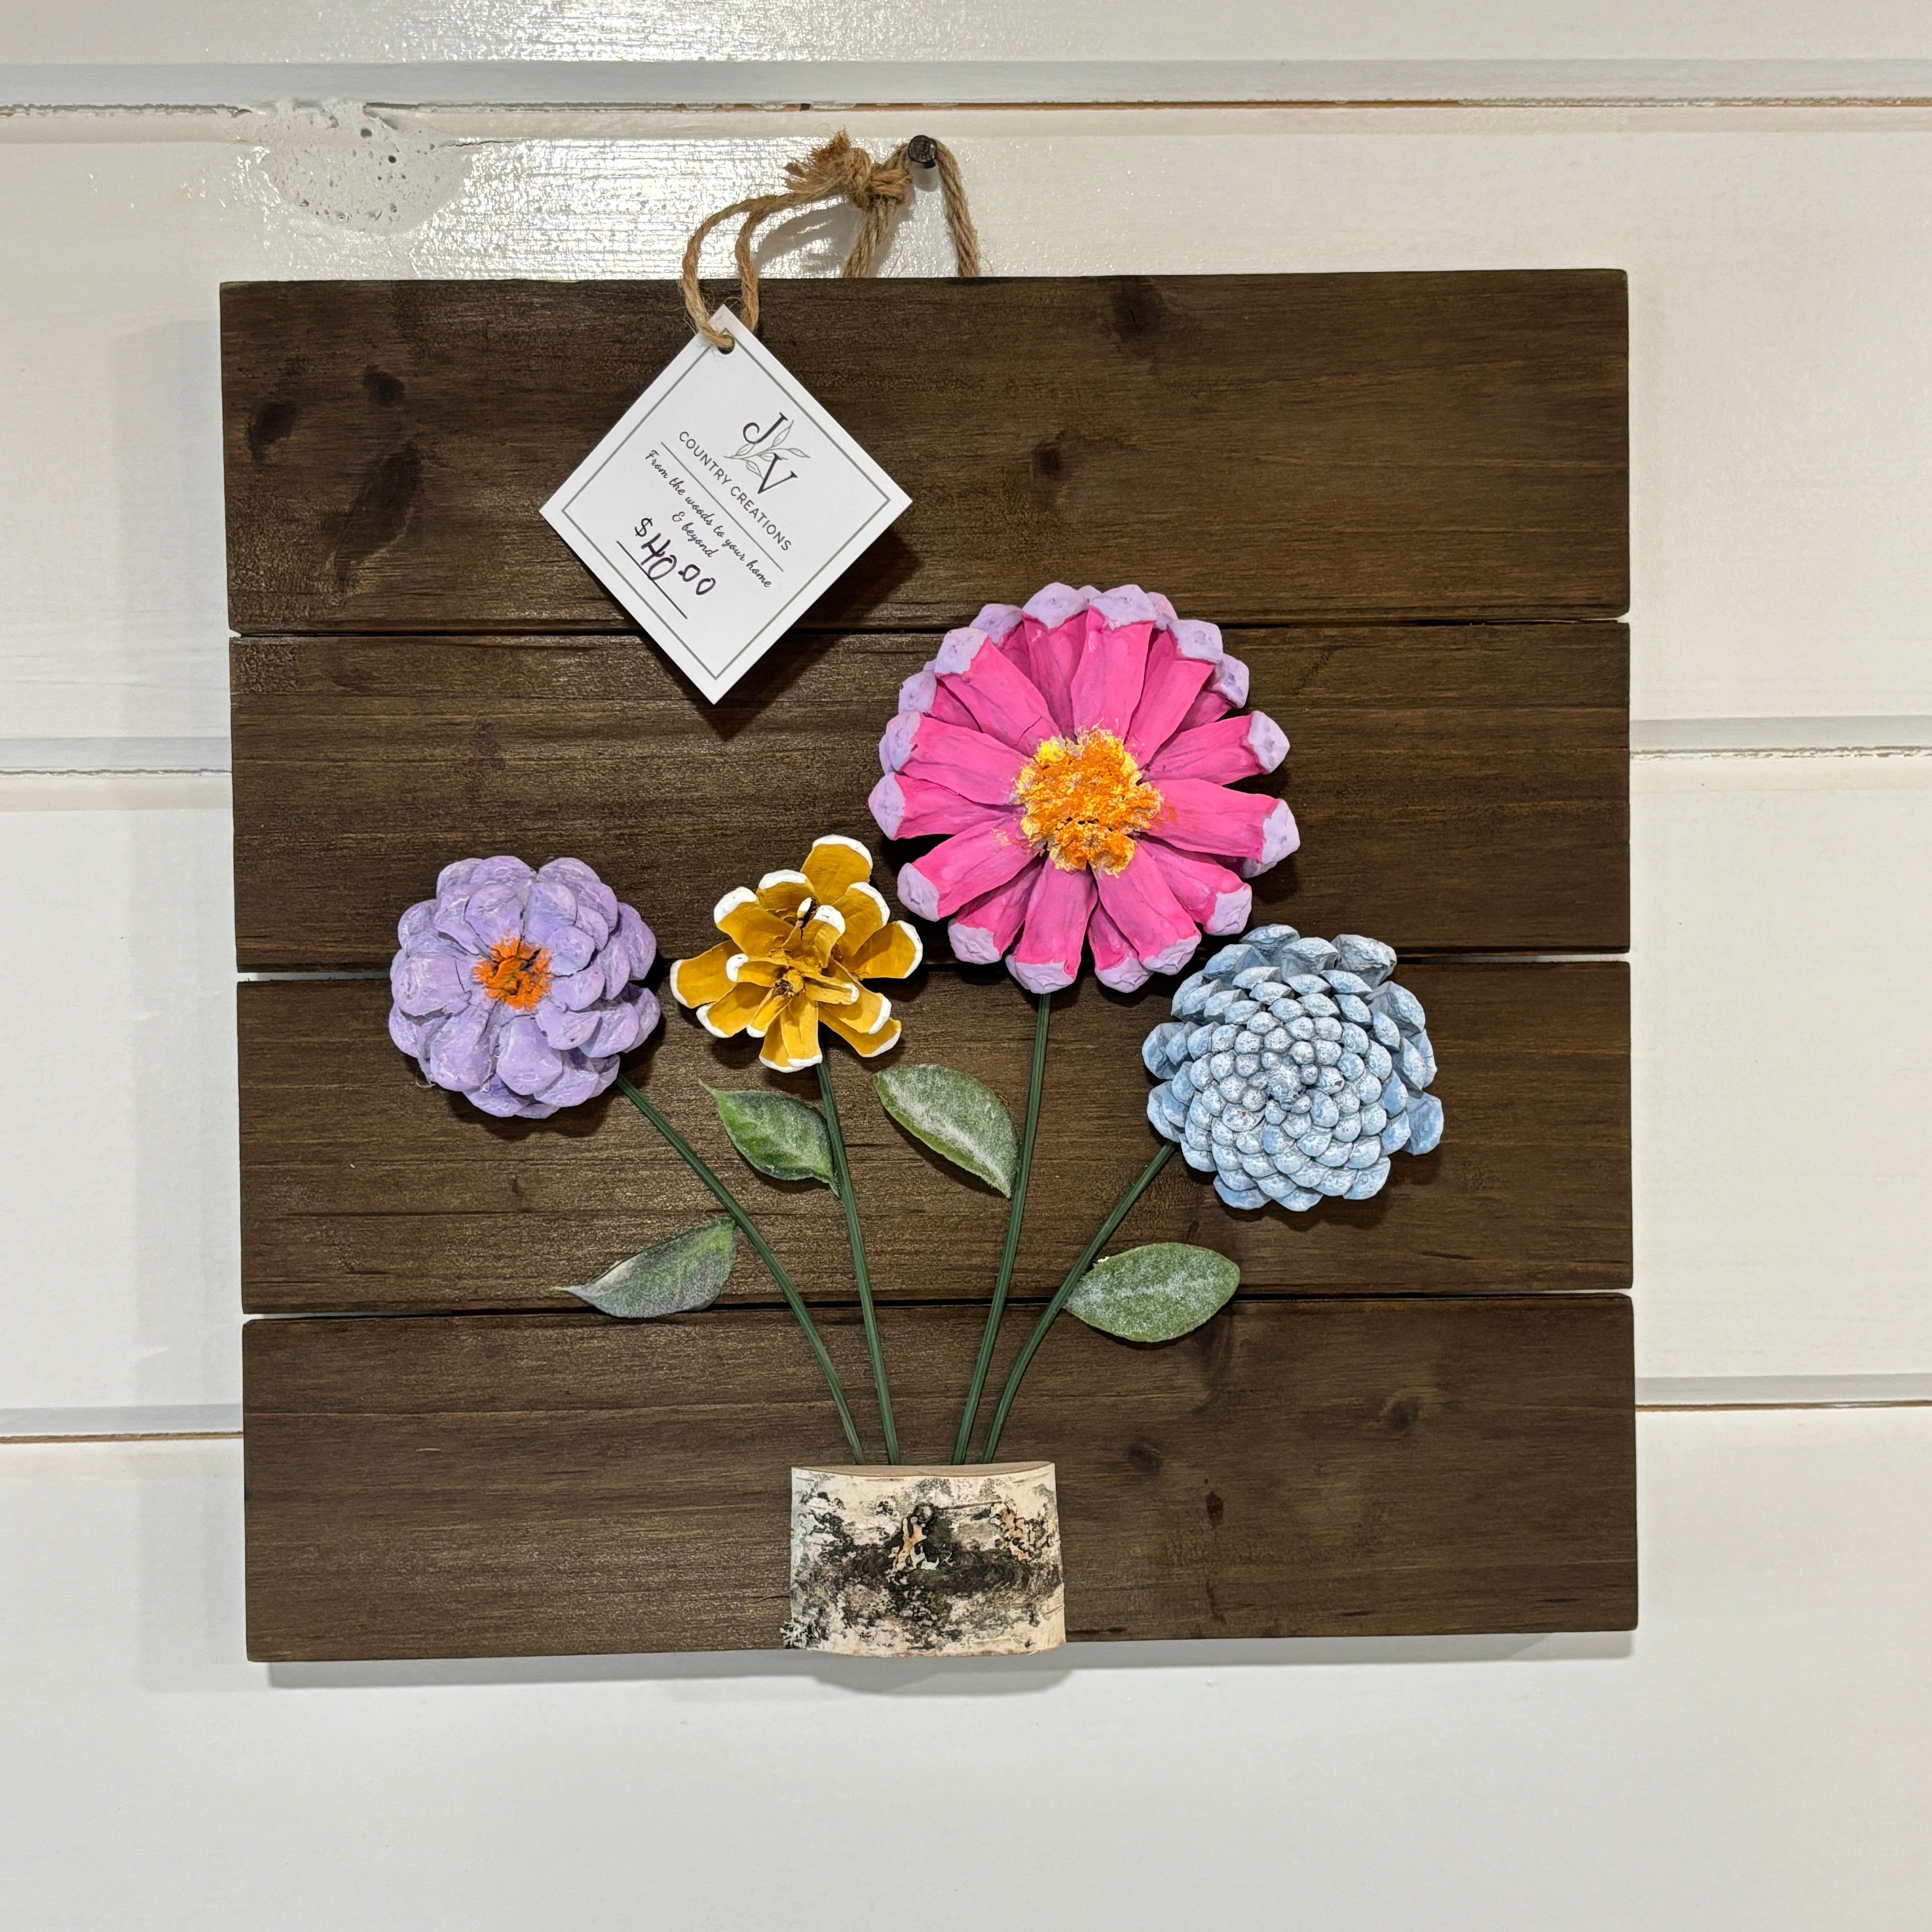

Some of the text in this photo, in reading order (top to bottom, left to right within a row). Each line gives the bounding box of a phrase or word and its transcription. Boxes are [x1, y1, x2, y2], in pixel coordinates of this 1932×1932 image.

[645, 450, 772, 588] From the woods to your home
[672, 511, 719, 558] & beyond
[679, 431, 792, 551] COUNTRY CREATIONS
